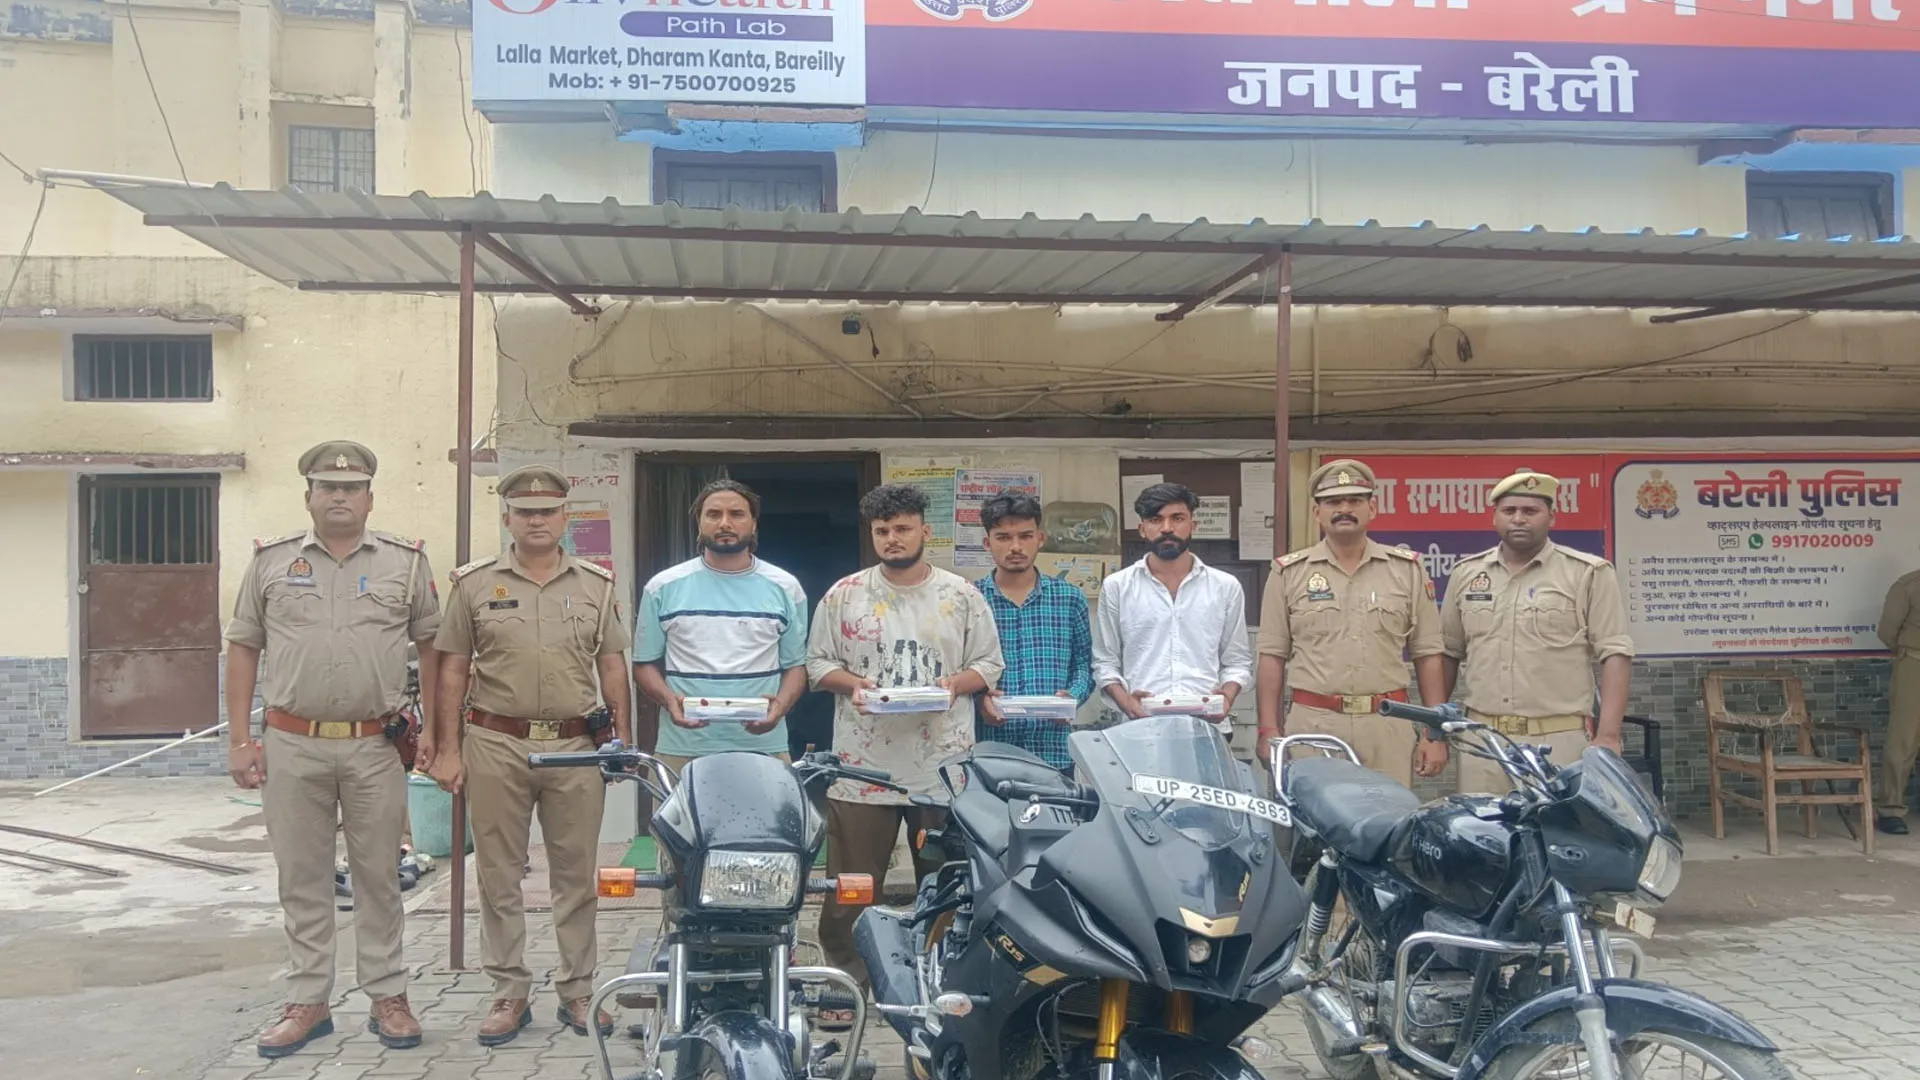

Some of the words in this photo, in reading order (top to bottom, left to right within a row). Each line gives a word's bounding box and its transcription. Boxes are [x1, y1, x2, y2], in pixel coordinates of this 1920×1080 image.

[667, 16, 725, 35] Path
[736, 18, 786, 36] Lab
[496, 44, 541, 64] Lalla
[550, 45, 623, 67] Market,
[627, 47, 704, 69] Dharam
[709, 48, 771, 72] Kanta,
[775, 50, 845, 77] Bareilly
[549, 72, 605, 89] Mob:
[1224, 60, 1421, 113] जनपद
[1482, 51, 1639, 114] बरेली
[1694, 469, 1792, 508] बरेली
[1797, 469, 1902, 517] पुलिस
[1707, 521, 1750, 533] व्हाट्सएप
[1837, 519, 1865, 531] सूचना
[1866, 517, 1882, 531] हेतु
[1721, 538, 1738, 546] SMS
[1771, 534, 1874, 548] 9917020009
[1157, 780, 1180, 796] UP
[1190, 785, 1237, 807] 25ED
